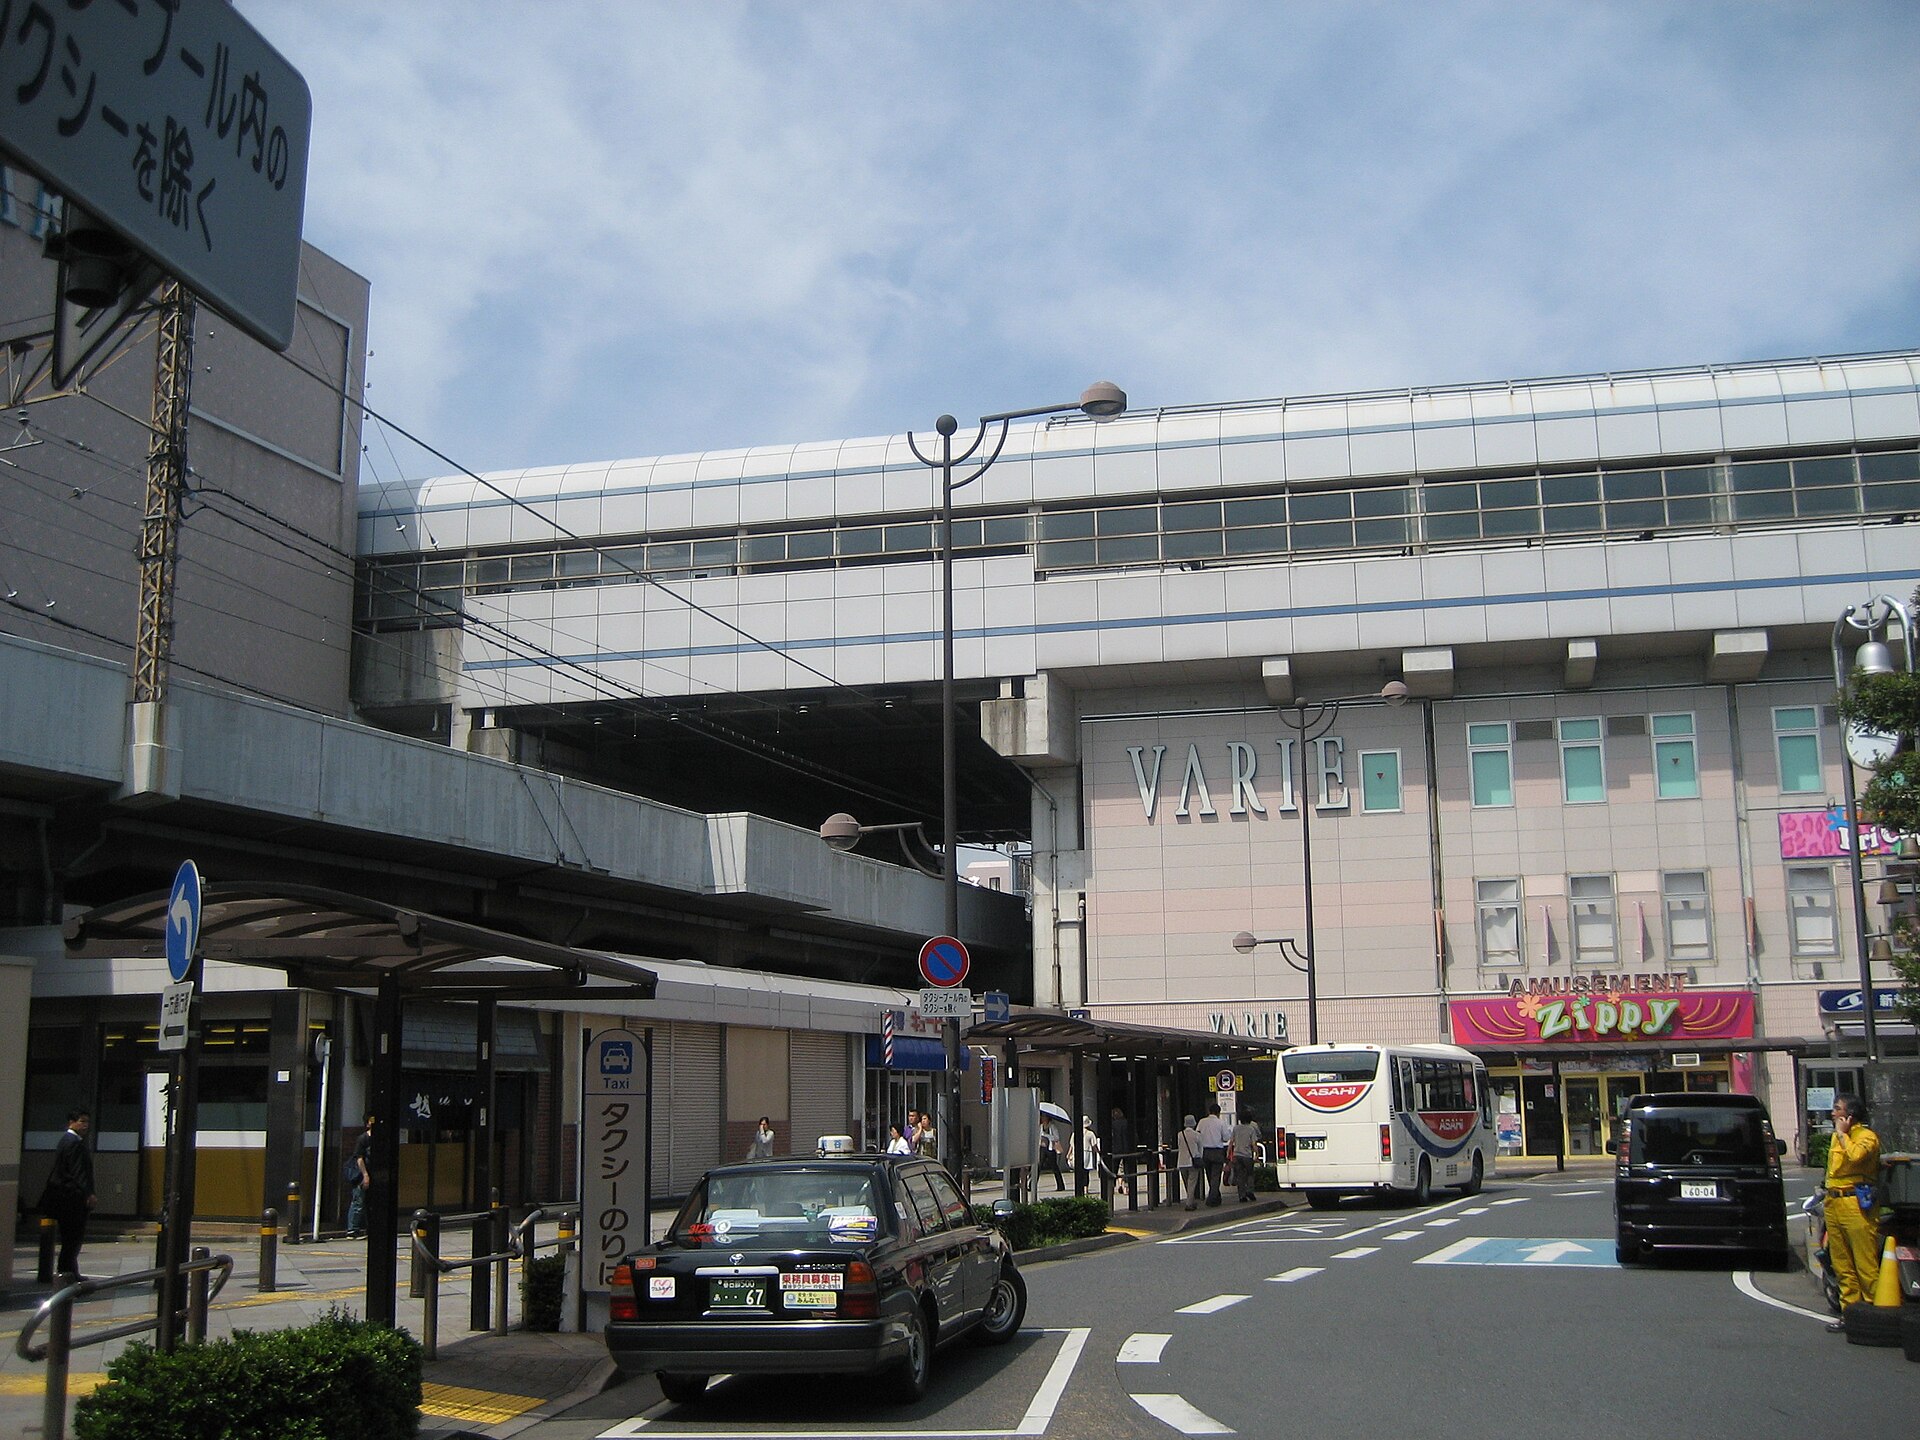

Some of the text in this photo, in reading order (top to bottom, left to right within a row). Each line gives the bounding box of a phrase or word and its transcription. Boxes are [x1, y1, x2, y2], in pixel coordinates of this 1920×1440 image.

[66, 0, 289, 191] ープール内の
[0, 0, 217, 252] クシーを除く
[1126, 736, 1349, 818] VARIE
[1508, 972, 1688, 998] AMUSEMENT
[923, 993, 968, 1003] タクシープール内の
[923, 1003, 957, 1014] タクシーを除く
[1208, 1012, 1287, 1038] VARIE
[1535, 998, 1680, 1039] Zippy
[603, 1077, 630, 1090] Taxi
[1306, 1087, 1357, 1097] ASAHI
[1307, 1140, 1324, 1150] 380
[1689, 1187, 1715, 1197] 60-04
[746, 1288, 764, 1306] 67
